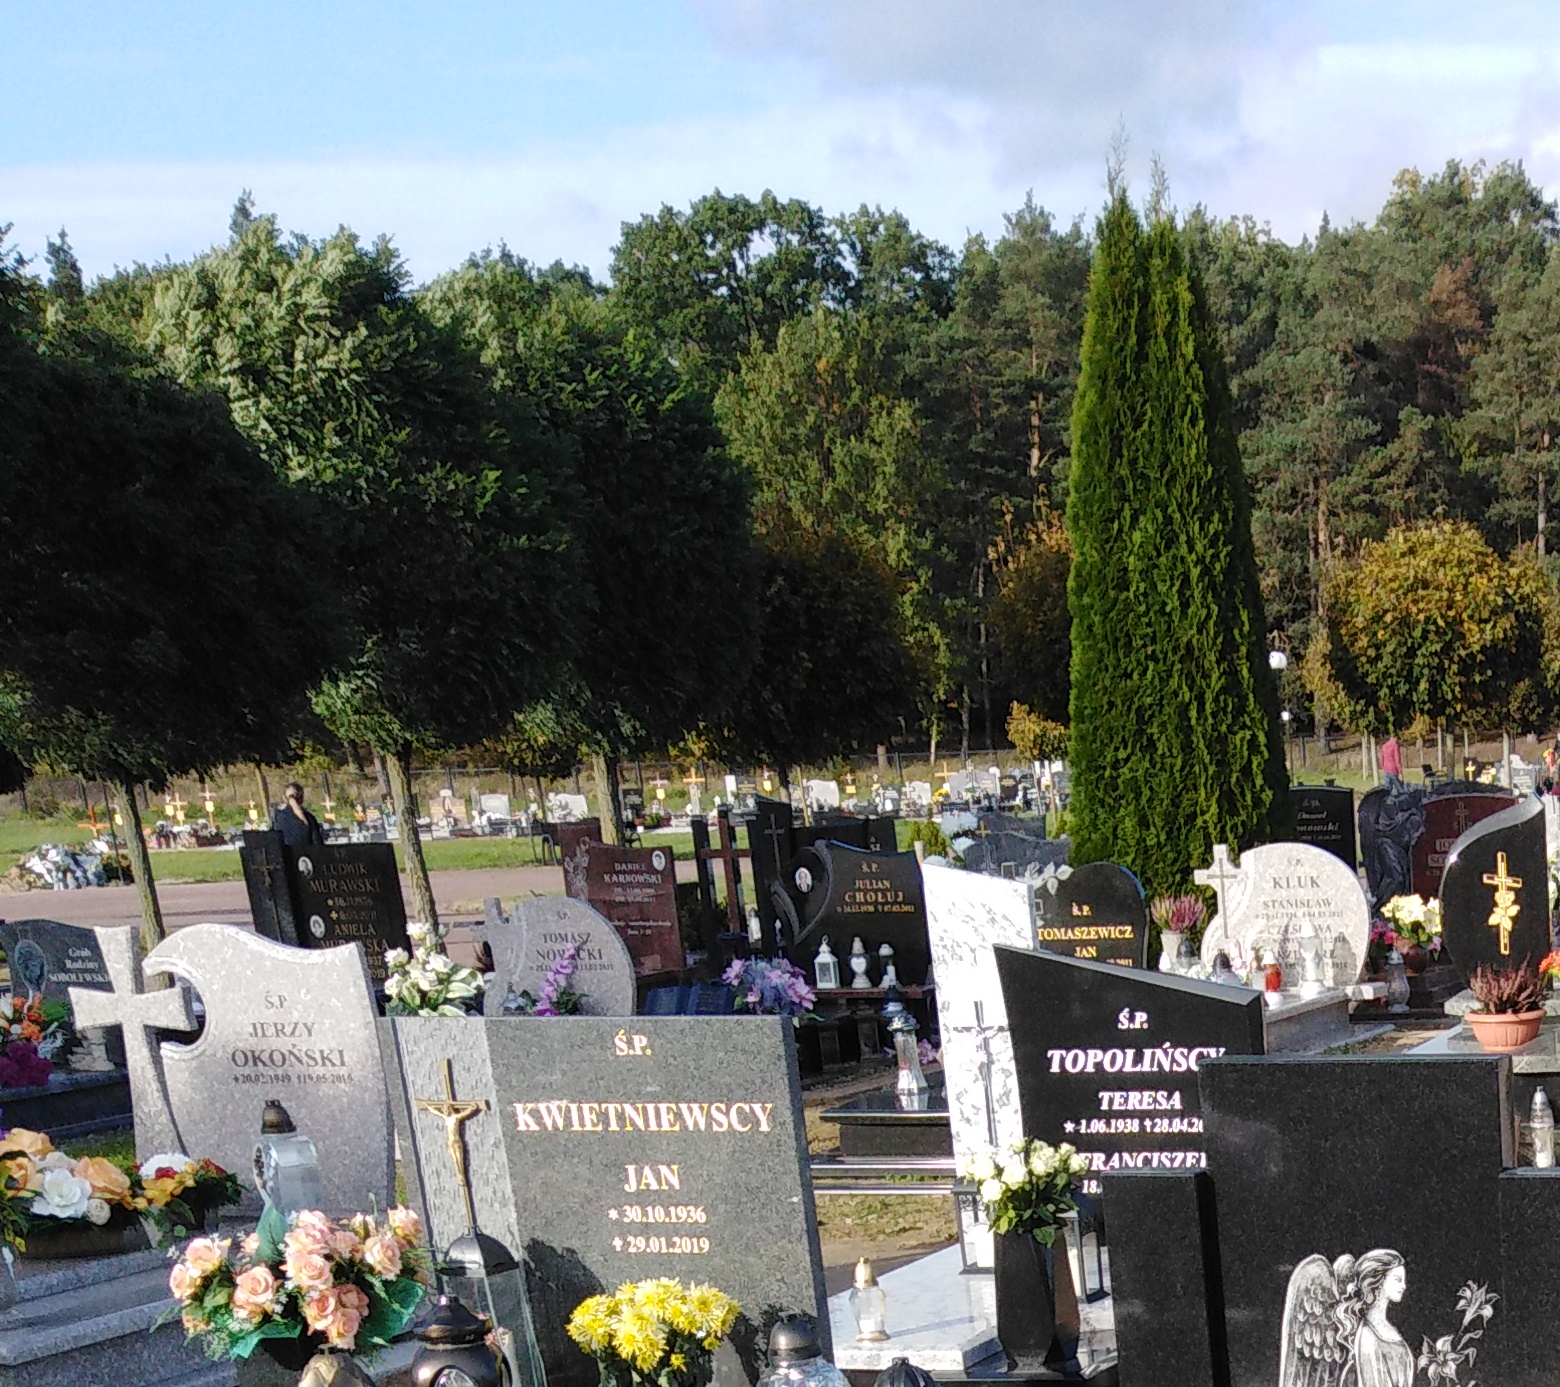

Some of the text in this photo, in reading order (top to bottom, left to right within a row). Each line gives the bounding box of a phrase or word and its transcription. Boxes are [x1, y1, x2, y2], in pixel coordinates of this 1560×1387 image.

[854, 879, 891, 889] JULIAN
[1272, 876, 1321, 889] KLUK
[334, 923, 377, 936] ANIELA
[543, 931, 593, 944] TOMASZ
[1037, 925, 1134, 940] TOMASZEWICZ
[1074, 945, 1097, 958] JAN
[1117, 1007, 1149, 1030] Ś.P.
[249, 1021, 316, 1038] JERZY
[614, 1029, 652, 1056] Ś.P.
[231, 1043, 348, 1068] OKOŃSKI
[1099, 1090, 1183, 1111] TERESA
[513, 1102, 774, 1133] KWIETNIEWSCY
[623, 1164, 681, 1193] JAN
[622, 1205, 707, 1224] 30.10.1936
[626, 1236, 710, 1254] 29.01.2019
